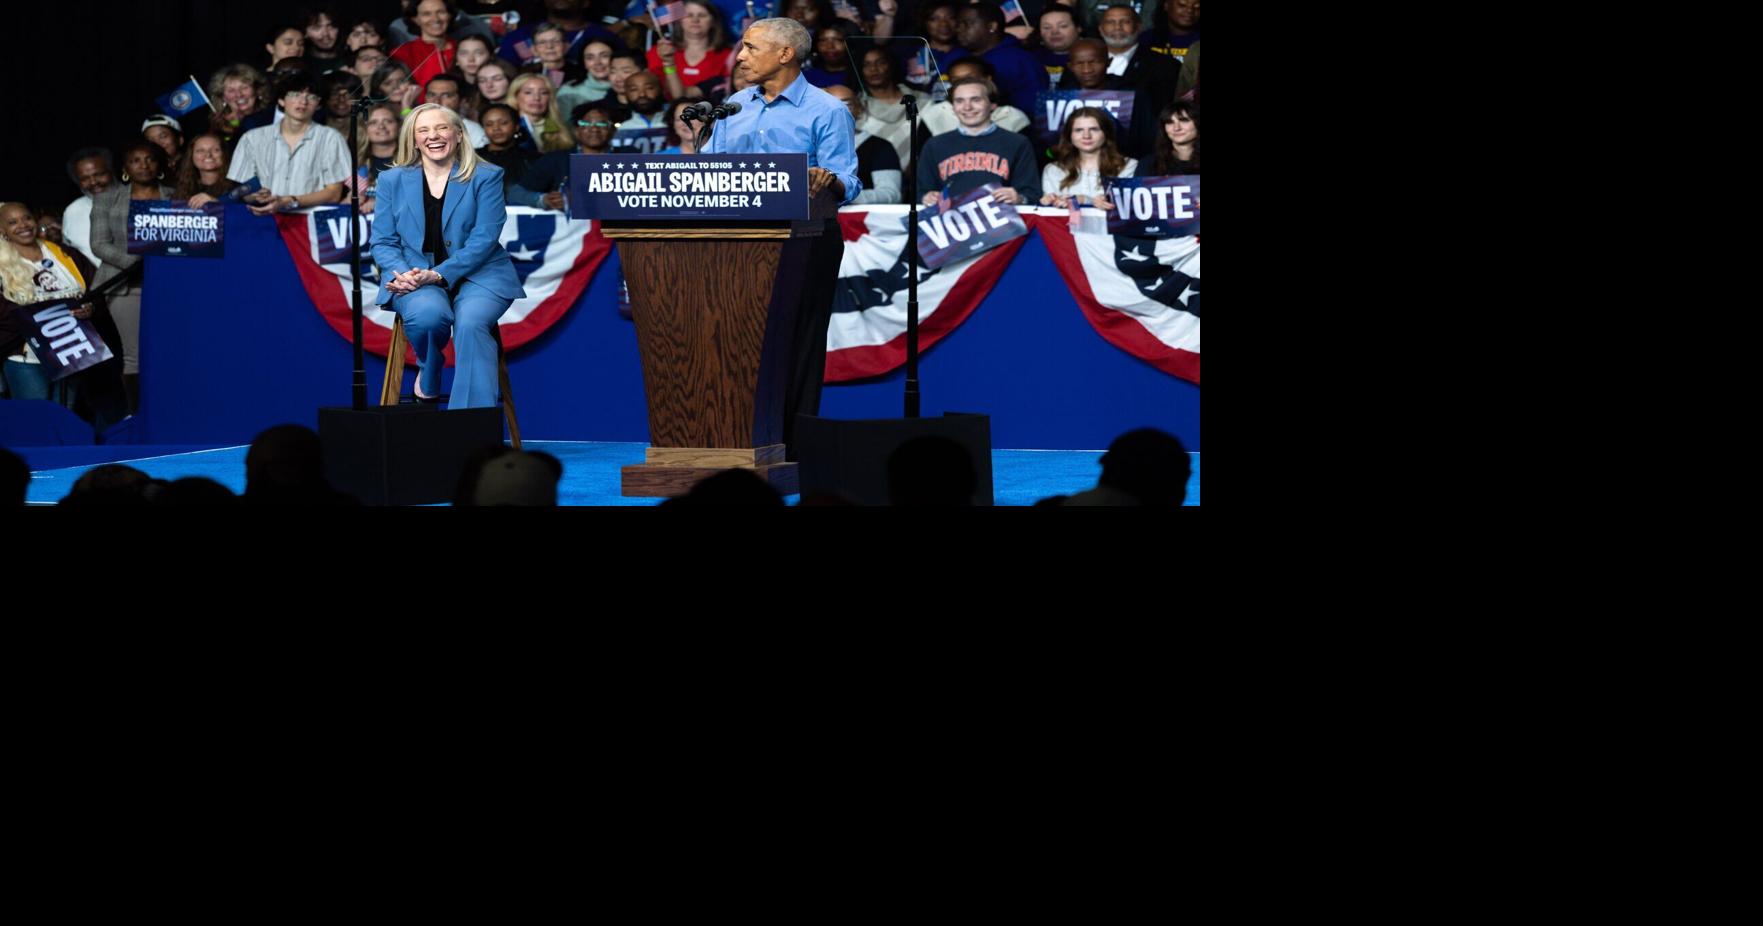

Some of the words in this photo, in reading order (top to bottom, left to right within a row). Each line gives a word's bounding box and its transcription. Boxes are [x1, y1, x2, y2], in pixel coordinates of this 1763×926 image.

[645, 162, 665, 170] TEXT
[665, 162, 698, 170] ABIGAIL
[699, 162, 710, 170] TO
[710, 162, 733, 170] 55105
[938, 151, 1010, 181] VIRGINIA
[588, 172, 667, 193] ABIGAIL
[669, 171, 791, 193] SPANBERGER
[617, 195, 659, 208] VOTE
[661, 195, 750, 208] NOVEMBER
[752, 195, 763, 208] 4
[1112, 185, 1195, 221] VOTE
[134, 214, 218, 230] SPANBERGER
[918, 194, 1011, 250] VOTE
[134, 228, 158, 241] FOR
[160, 229, 217, 243] VIRGINIA
[32, 303, 96, 367] VOTE
